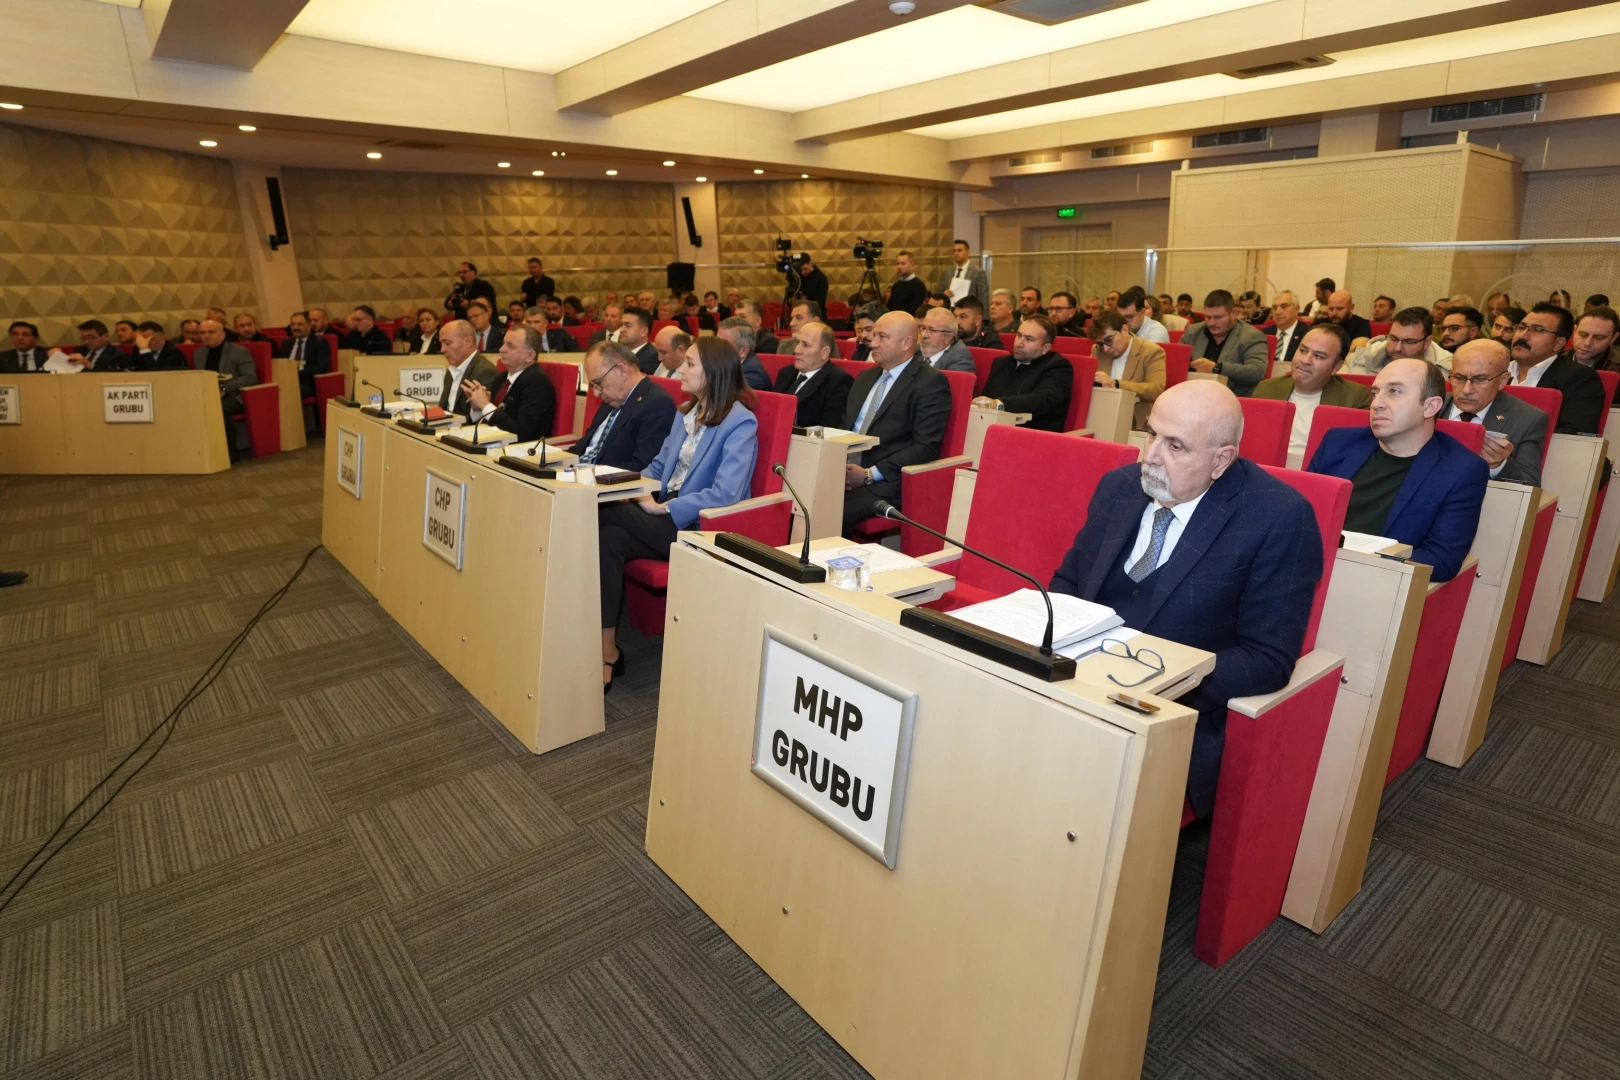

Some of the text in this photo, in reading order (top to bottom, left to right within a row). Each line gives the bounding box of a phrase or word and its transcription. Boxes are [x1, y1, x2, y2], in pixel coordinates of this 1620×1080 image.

[412, 372, 432, 382] CHP
[107, 388, 149, 400] AK PARTİ
[406, 387, 440, 396] GRUBU
[113, 404, 144, 413] GRUBU
[344, 441, 354, 458] CHP
[434, 486, 451, 512] CHP
[428, 516, 455, 549] GRUBU
[793, 675, 863, 742] MHP
[772, 729, 876, 822] GRUBU
